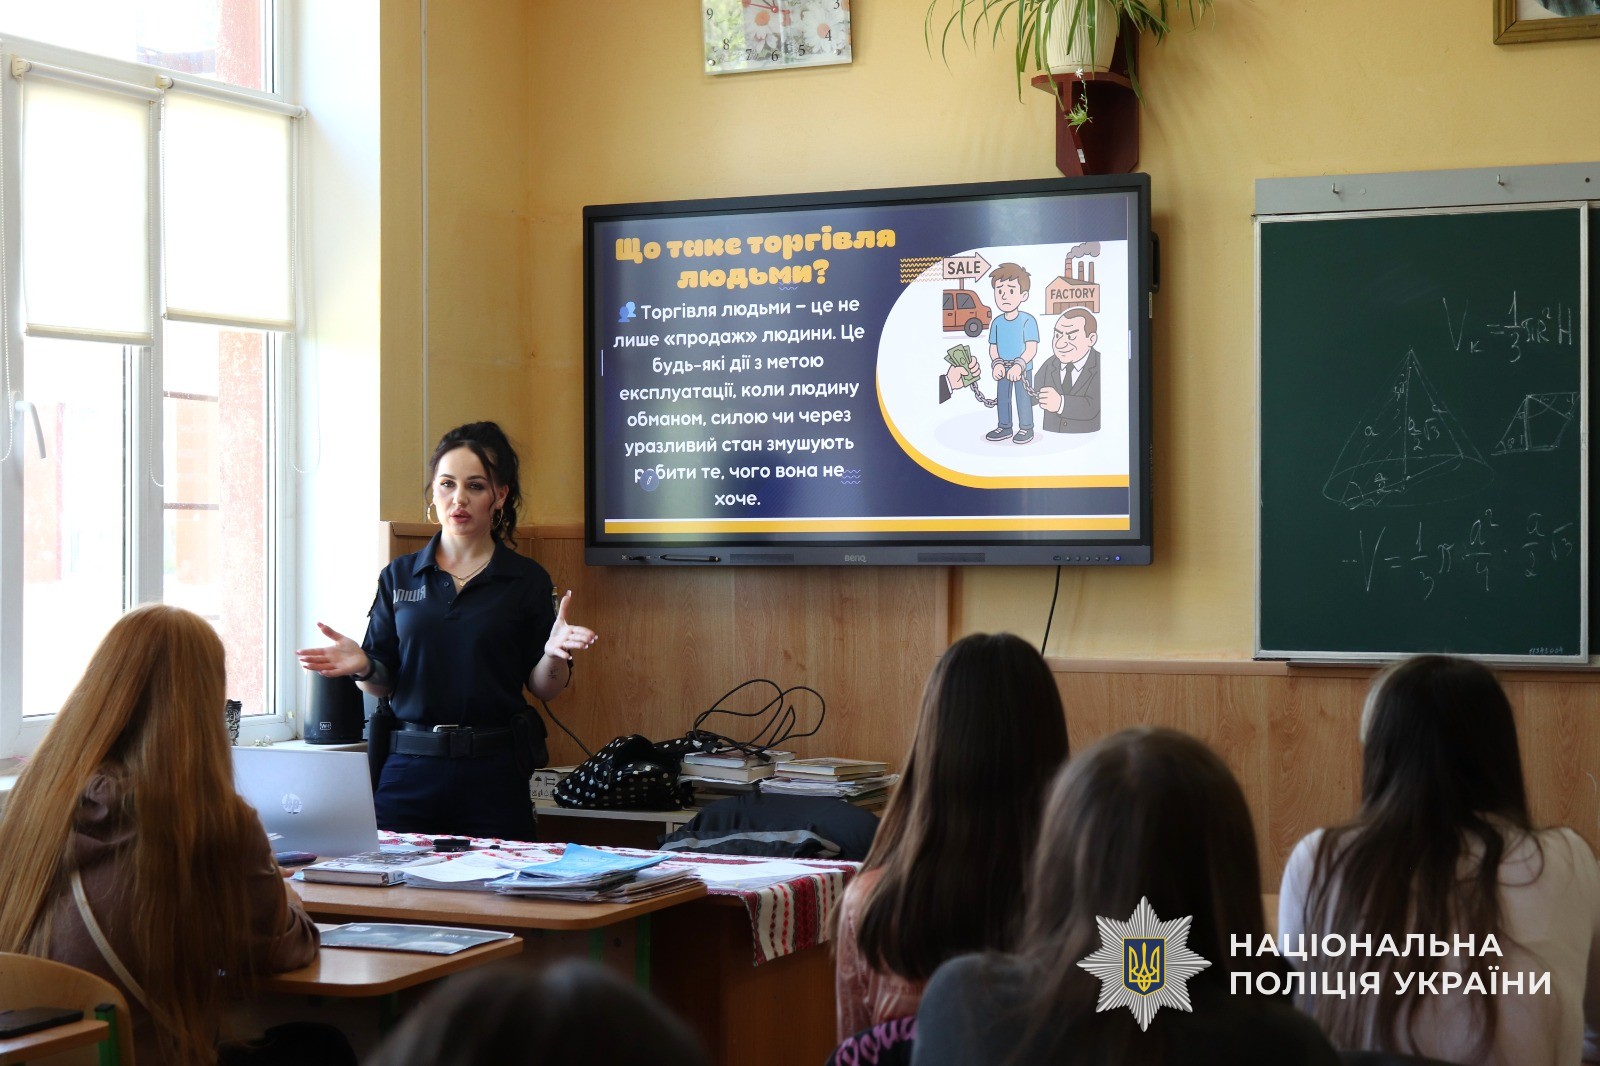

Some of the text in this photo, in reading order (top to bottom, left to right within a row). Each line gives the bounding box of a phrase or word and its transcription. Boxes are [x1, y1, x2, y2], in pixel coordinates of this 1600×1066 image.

[706, 8, 714, 20] 9
[824, 29, 832, 41] 4
[722, 38, 730, 50] 8
[798, 44, 806, 56] 5
[746, 48, 753, 60] 7
[771, 50, 779, 61] 6
[615, 225, 896, 264] Що таке торгівля
[677, 259, 829, 289] людьми?
[947, 261, 981, 275] SALE
[1050, 287, 1095, 300] FACTORY
[640, 302, 717, 322] Торгівля
[721, 302, 791, 319] людьми
[811, 300, 834, 316] це
[838, 299, 860, 312] не
[613, 324, 866, 350] лише «продаж» людини. Це
[652, 354, 824, 376] будь-які дії з метою
[619, 382, 860, 403] експлуатації, коли людину
[627, 409, 852, 428] обманом, силою чи через
[624, 436, 855, 457] уразливий стан змушують
[634, 463, 845, 484] рбити те, чого вона не
[714, 492, 761, 507] хоче.
[844, 554, 867, 563] BenQ
